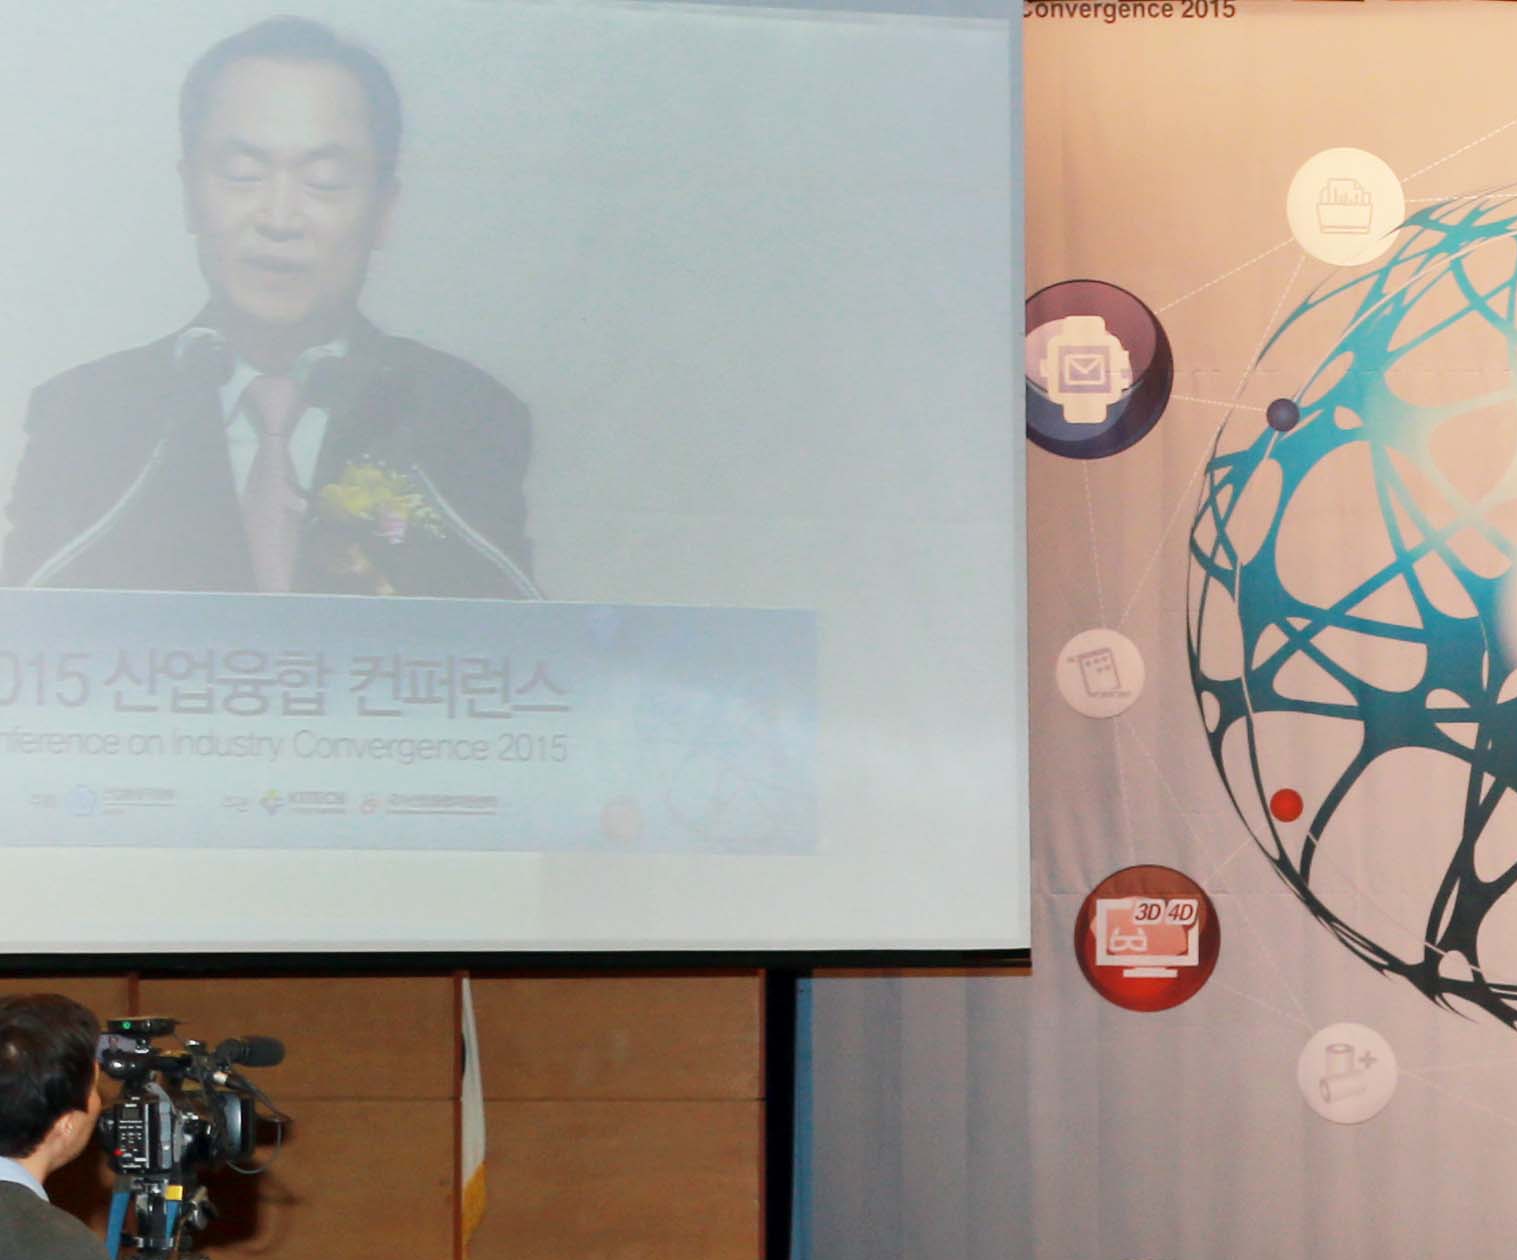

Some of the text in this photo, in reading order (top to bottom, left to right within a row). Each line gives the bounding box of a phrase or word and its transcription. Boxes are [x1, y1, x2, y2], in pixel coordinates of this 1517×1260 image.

[1181, 0, 1236, 18] 2015
[0, 647, 573, 720] 015 산업융합 컨퍼런스
[127, 733, 164, 755] on
[173, 728, 281, 763] Industry
[294, 729, 490, 765] Convergence
[499, 733, 570, 763] 2015
[1135, 902, 1161, 921] 3D
[1168, 903, 1194, 921] 4D
